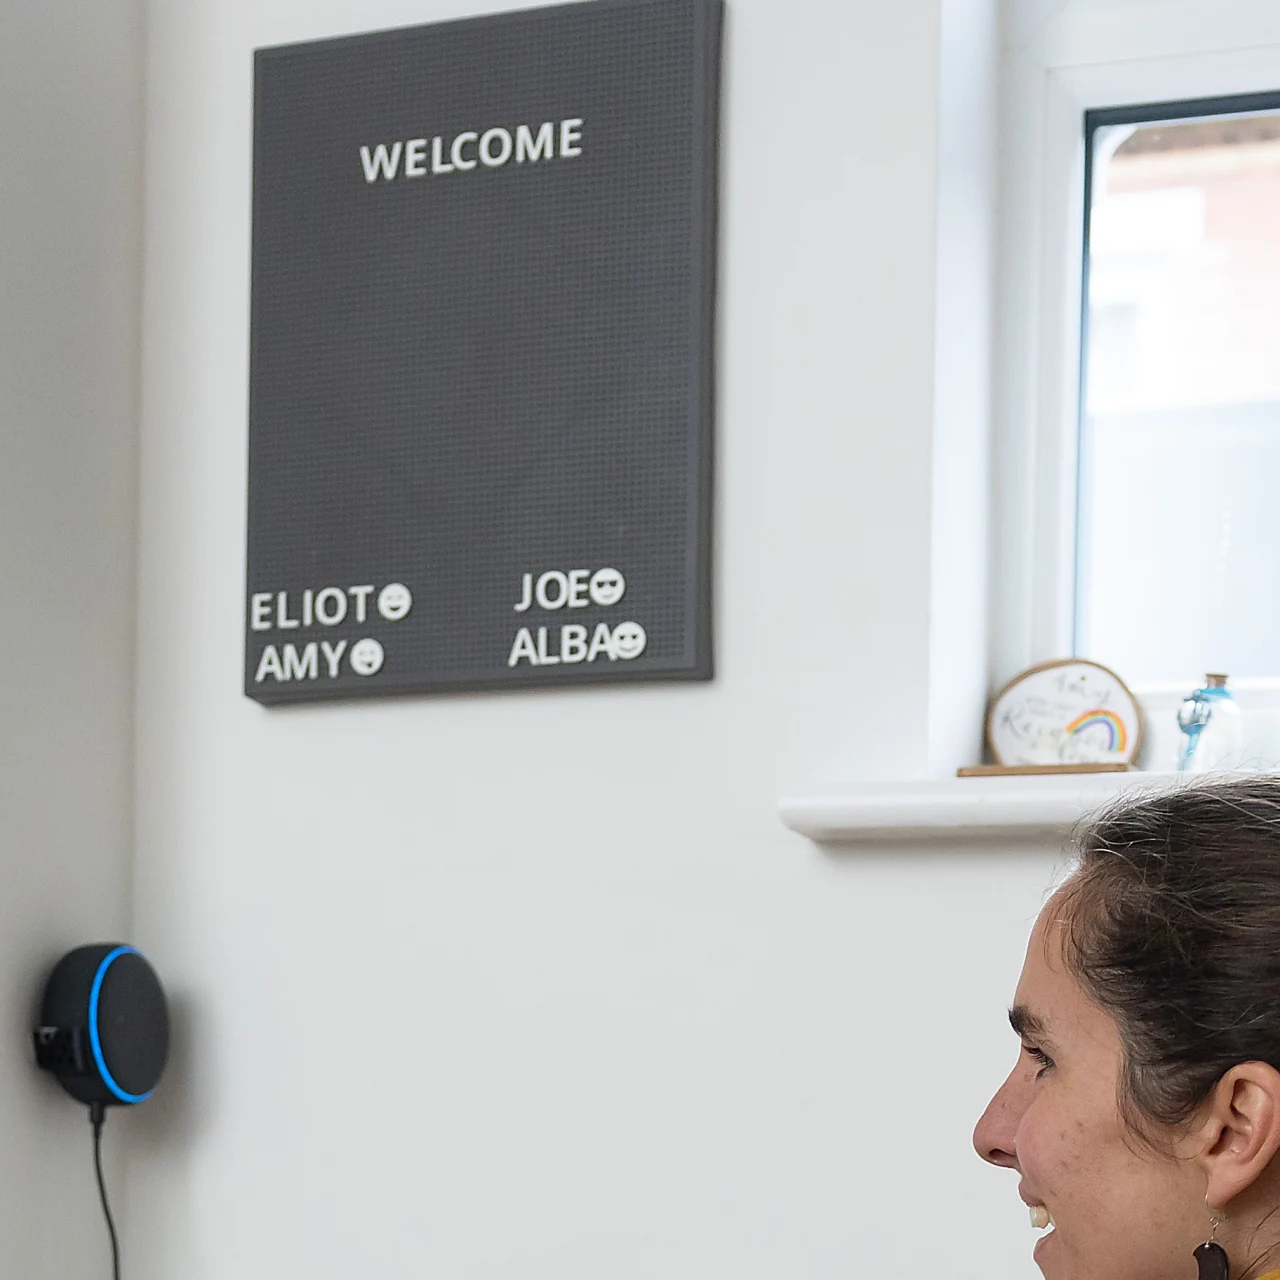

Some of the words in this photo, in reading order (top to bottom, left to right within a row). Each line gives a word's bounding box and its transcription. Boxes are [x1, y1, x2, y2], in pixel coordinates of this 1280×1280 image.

[360, 118, 583, 182] WELCOME
[251, 585, 375, 631] ELIOT
[514, 569, 590, 612] JOE
[254, 639, 348, 683] AMY
[508, 622, 620, 668] ALBA
